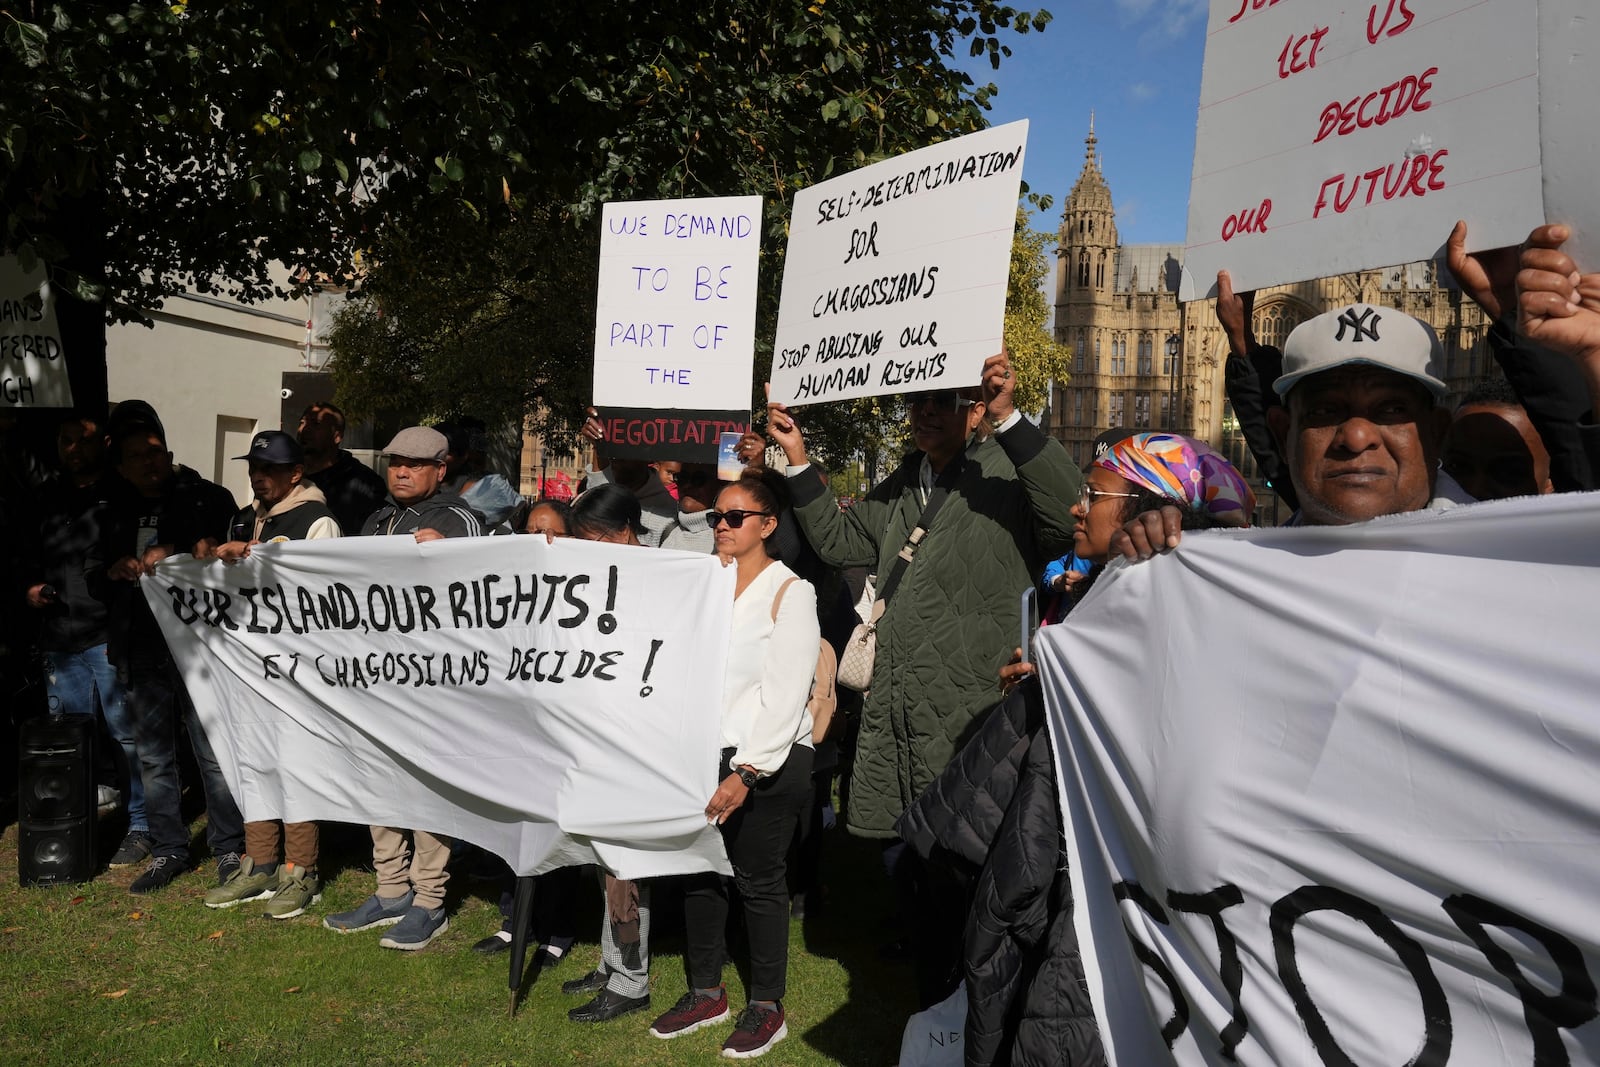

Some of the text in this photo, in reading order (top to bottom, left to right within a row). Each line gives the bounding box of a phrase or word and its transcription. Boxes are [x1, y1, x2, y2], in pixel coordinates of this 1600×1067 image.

[1278, 0, 1416, 79] LET US
[1312, 66, 1439, 144] DECIDE
[1221, 149, 1449, 242] OUR FUTURE
[609, 213, 752, 239] WE DEMAND
[844, 221, 880, 264] FOR
[631, 265, 733, 301] TO BE
[812, 265, 939, 319] CHAGOSSIANS
[610, 322, 729, 350] PART OF
[778, 321, 938, 370] STOP ABUSING OUR
[1335, 307, 1383, 343] NY
[0, 377, 35, 404] GH
[645, 368, 692, 385] THE
[793, 352, 947, 399] HUMAN RIGHTS
[167, 584, 239, 631] OUR
[367, 583, 441, 633] OUR
[315, 649, 489, 689] CHAGOSSIANS
[504, 646, 625, 684] DECIDE
